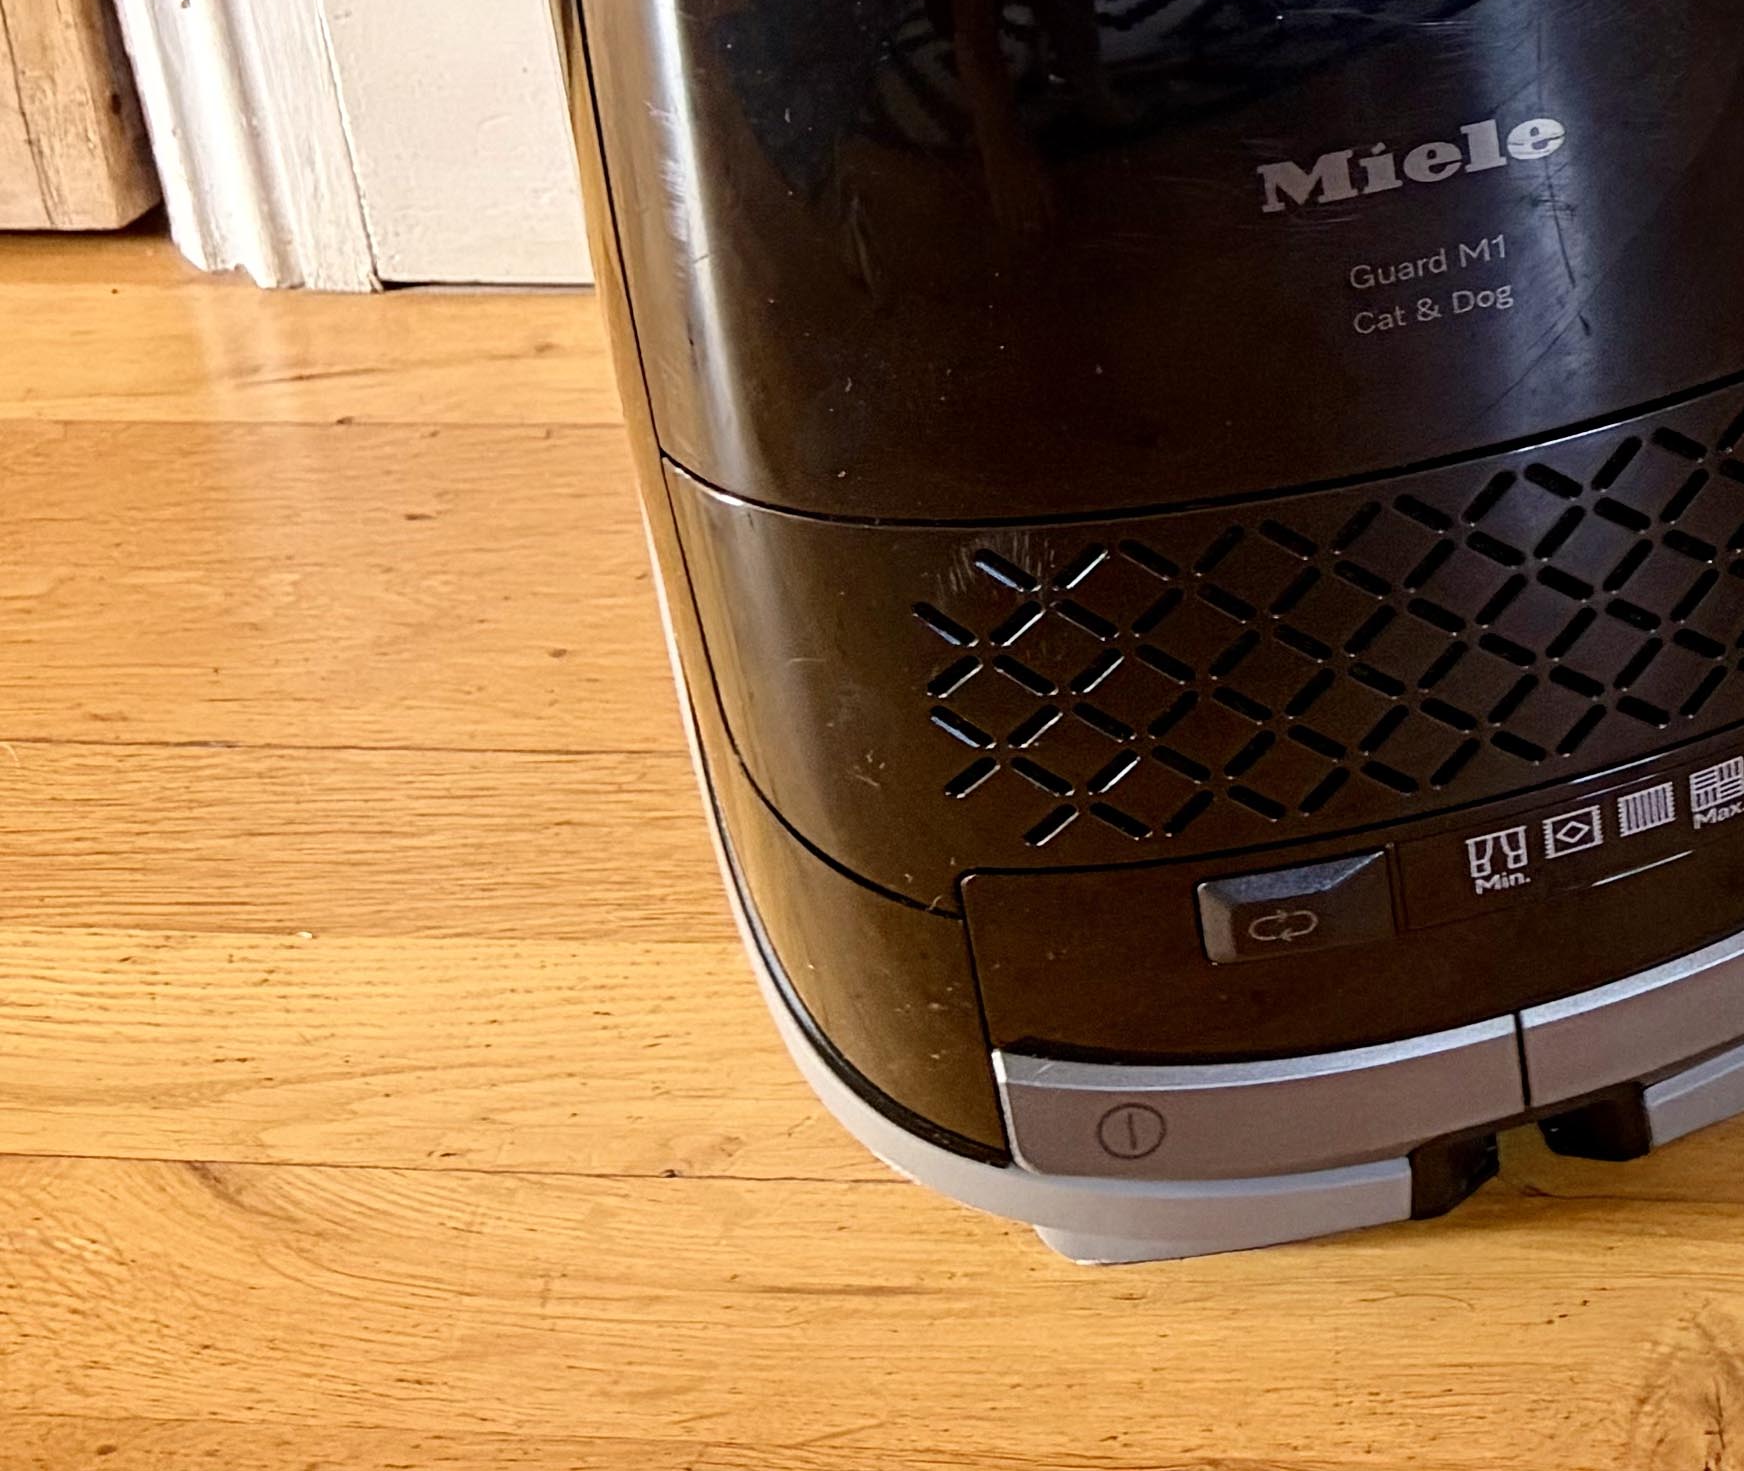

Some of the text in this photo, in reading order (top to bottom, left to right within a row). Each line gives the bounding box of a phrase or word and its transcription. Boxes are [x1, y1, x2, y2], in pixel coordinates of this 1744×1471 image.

[1256, 117, 1567, 214] Miele
[1349, 234, 1507, 290] Guard M1
[1352, 284, 1515, 335] Cat & Dog
[1474, 871, 1532, 895] Min.
